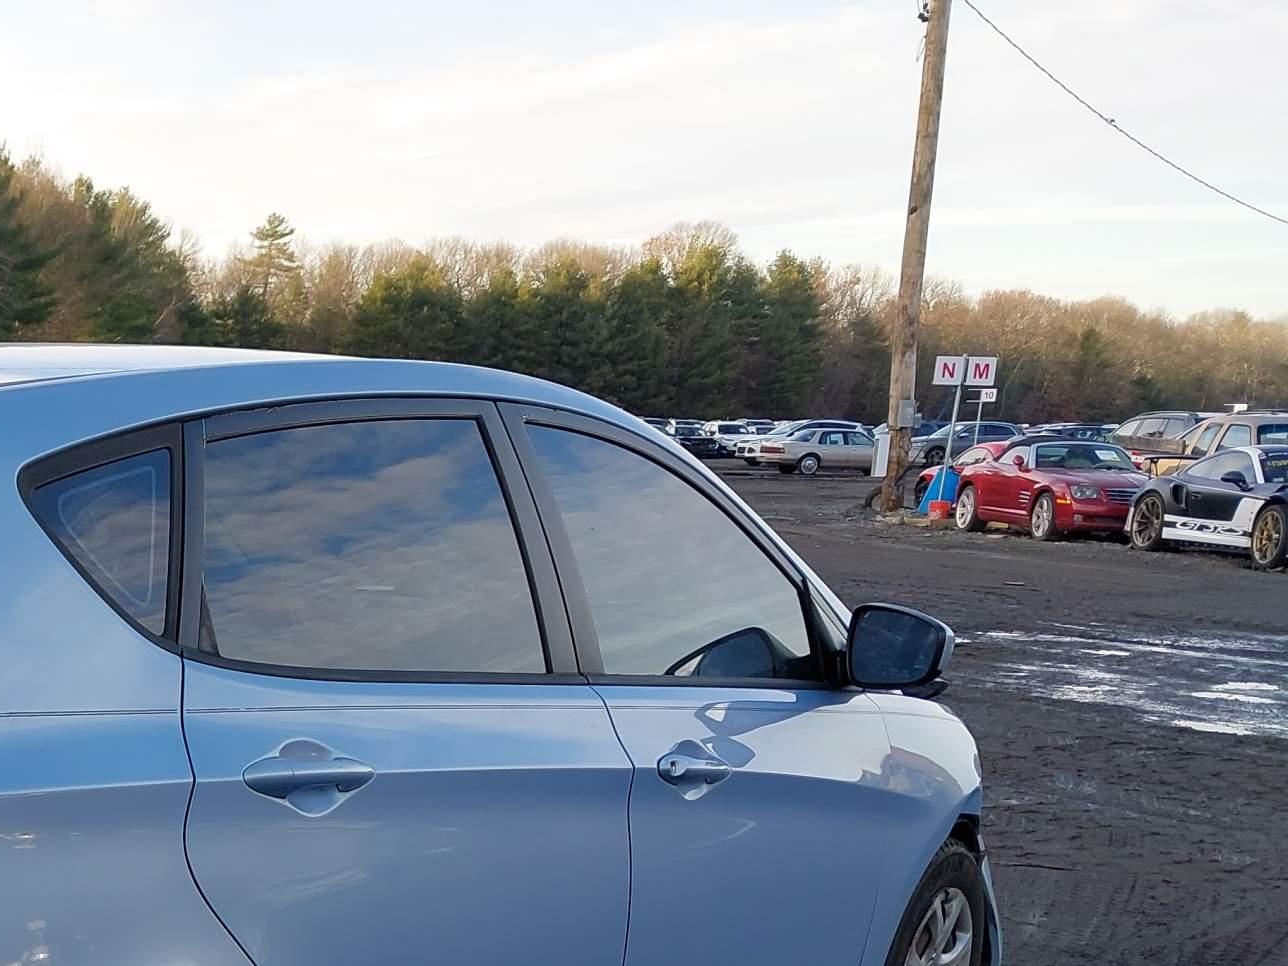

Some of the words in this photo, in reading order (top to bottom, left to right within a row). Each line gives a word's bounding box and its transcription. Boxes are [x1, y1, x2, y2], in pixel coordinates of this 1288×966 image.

[942, 362, 956, 378] N
[973, 363, 990, 379] M
[984, 391, 994, 399] 10
